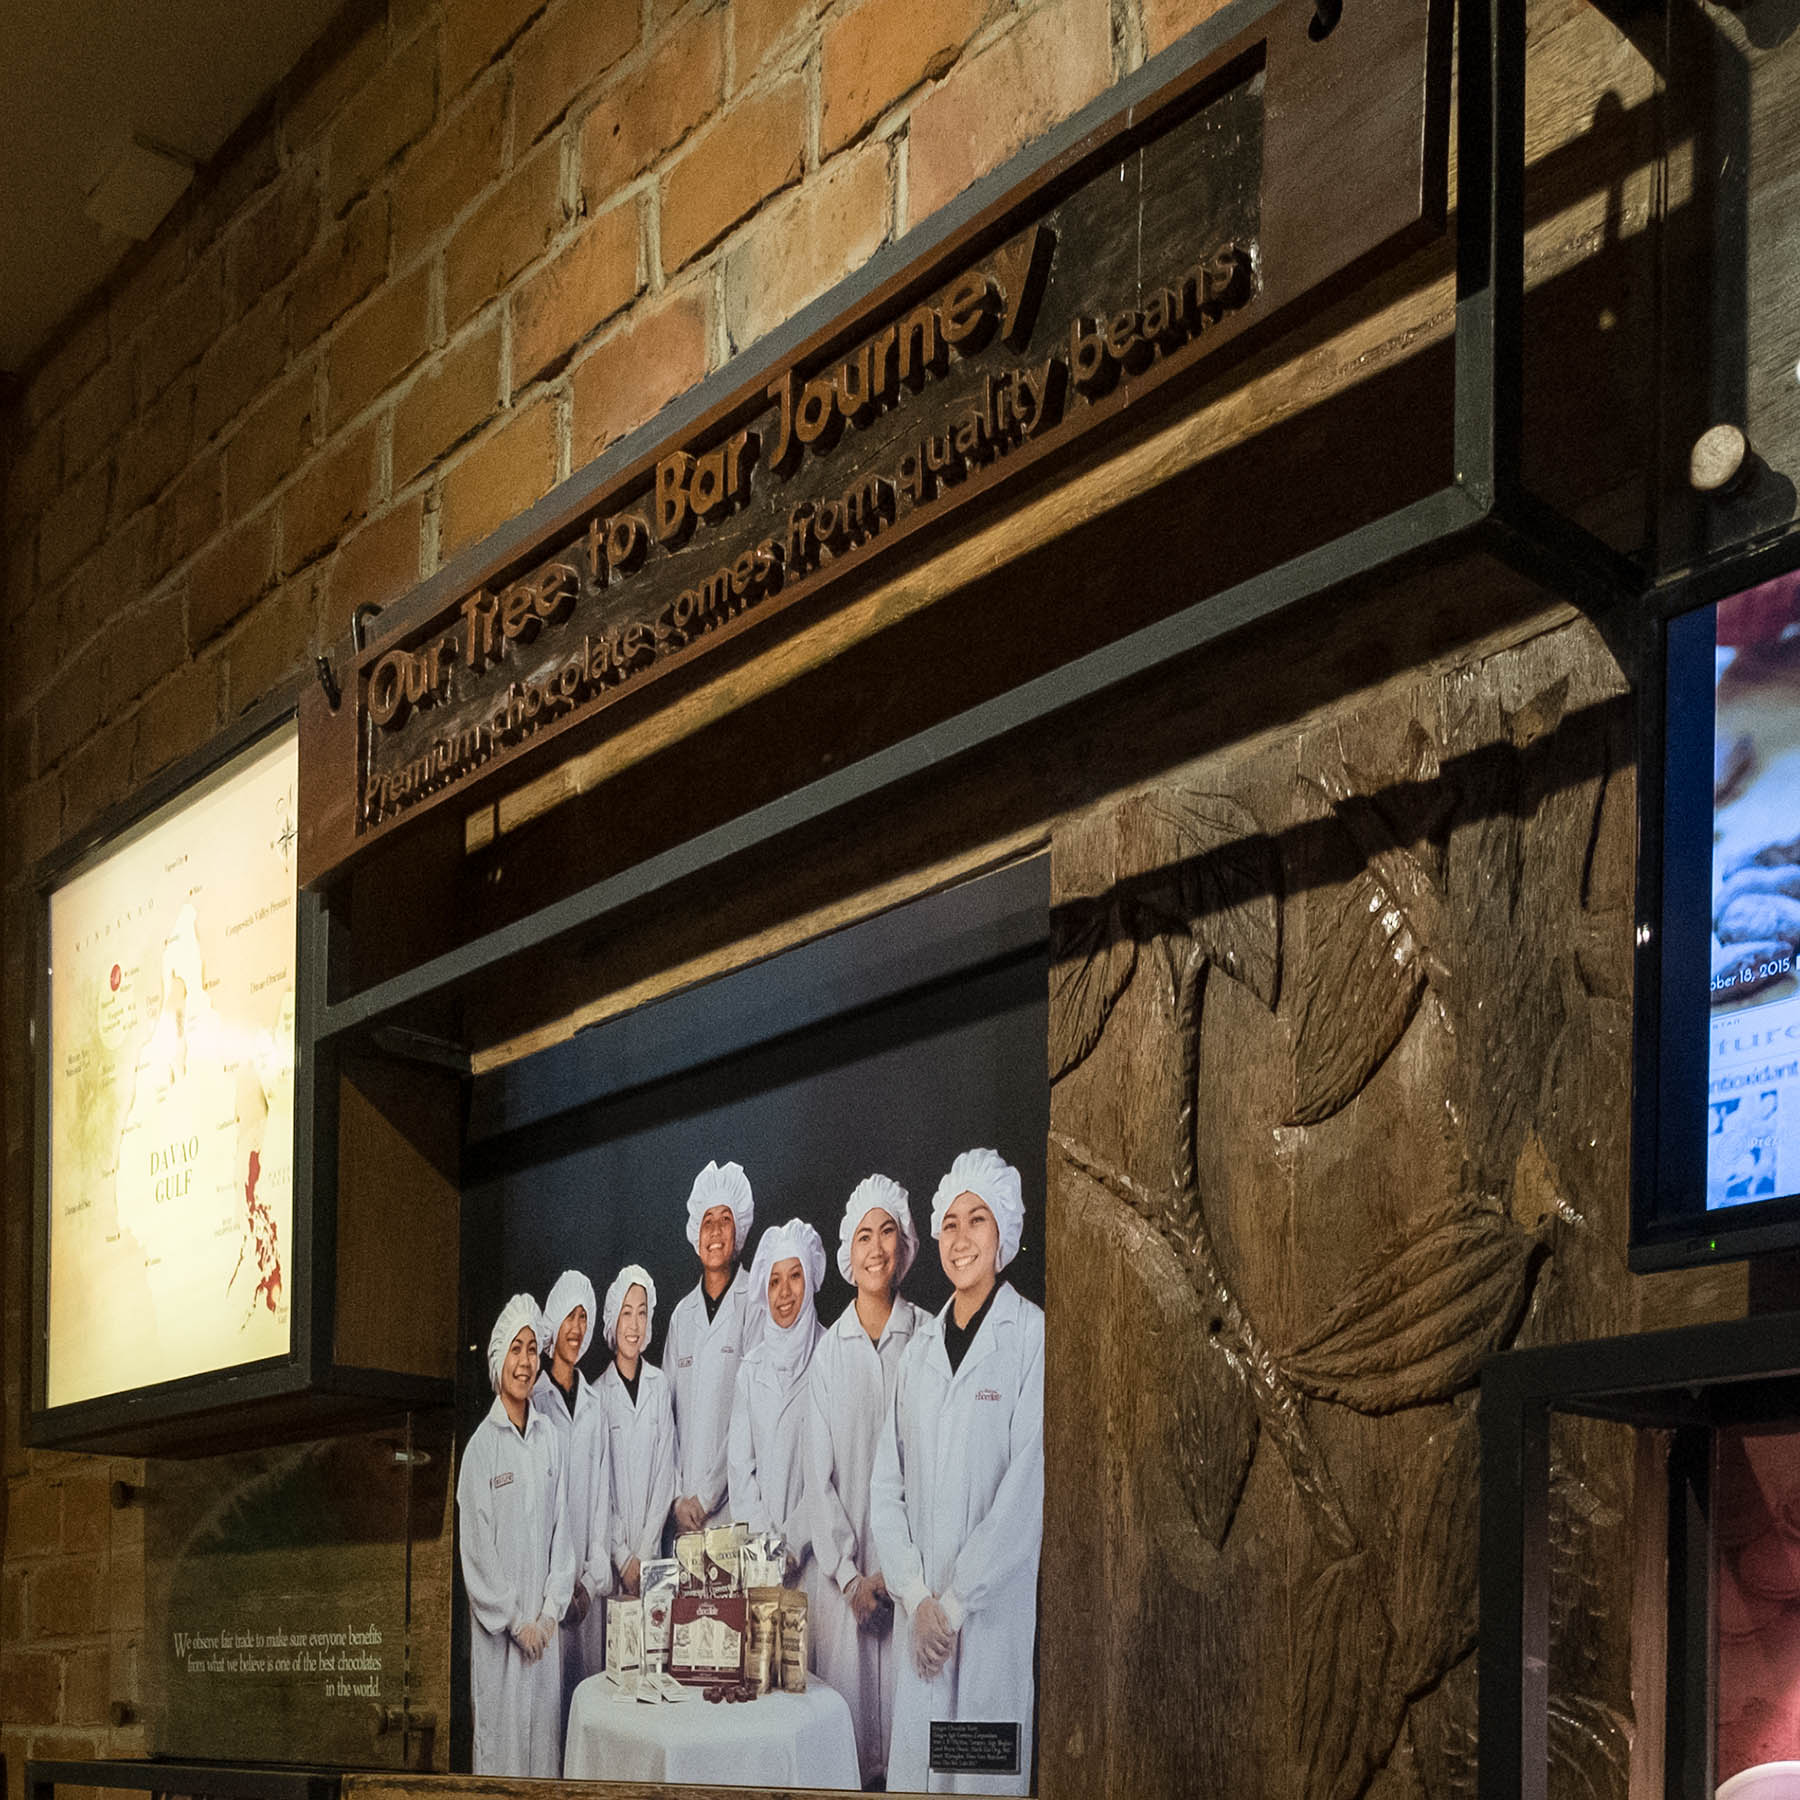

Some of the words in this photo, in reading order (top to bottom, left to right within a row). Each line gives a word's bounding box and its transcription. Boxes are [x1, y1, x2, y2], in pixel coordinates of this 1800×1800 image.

[368, 638, 450, 727] Our
[462, 563, 578, 670] Tree
[588, 514, 646, 576] to
[655, 431, 762, 541] Bar
[766, 224, 1053, 470] Journey
[493, 622, 656, 737] chocolate
[656, 540, 784, 640] comes
[786, 473, 896, 562] from
[900, 359, 1068, 500] quality
[1071, 242, 1250, 385] beans
[1759, 957, 1790, 980] 2015
[150, 1136, 199, 1177] DAVAO
[155, 1168, 193, 1204] GULF
[173, 1632, 191, 1658] We
[193, 1632, 219, 1649] observe
[221, 1629, 233, 1649] fair
[234, 1629, 254, 1648] trade
[255, 1632, 264, 1647] to
[266, 1627, 288, 1647] make
[290, 1634, 307, 1647] sure
[309, 1633, 347, 1652] everyone
[348, 1623, 383, 1646] benefits
[187, 1654, 205, 1673] from
[207, 1653, 225, 1672] what
[226, 1659, 239, 1672] we
[240, 1653, 265, 1672] believe
[267, 1656, 274, 1672] is
[275, 1659, 291, 1671] one
[292, 1652, 302, 1671] of
[303, 1652, 317, 1671] the
[318, 1651, 336, 1671] best
[337, 1649, 382, 1671] chocolates
[326, 1679, 335, 1697] in
[336, 1676, 352, 1697] the
[353, 1675, 381, 1697] world.
